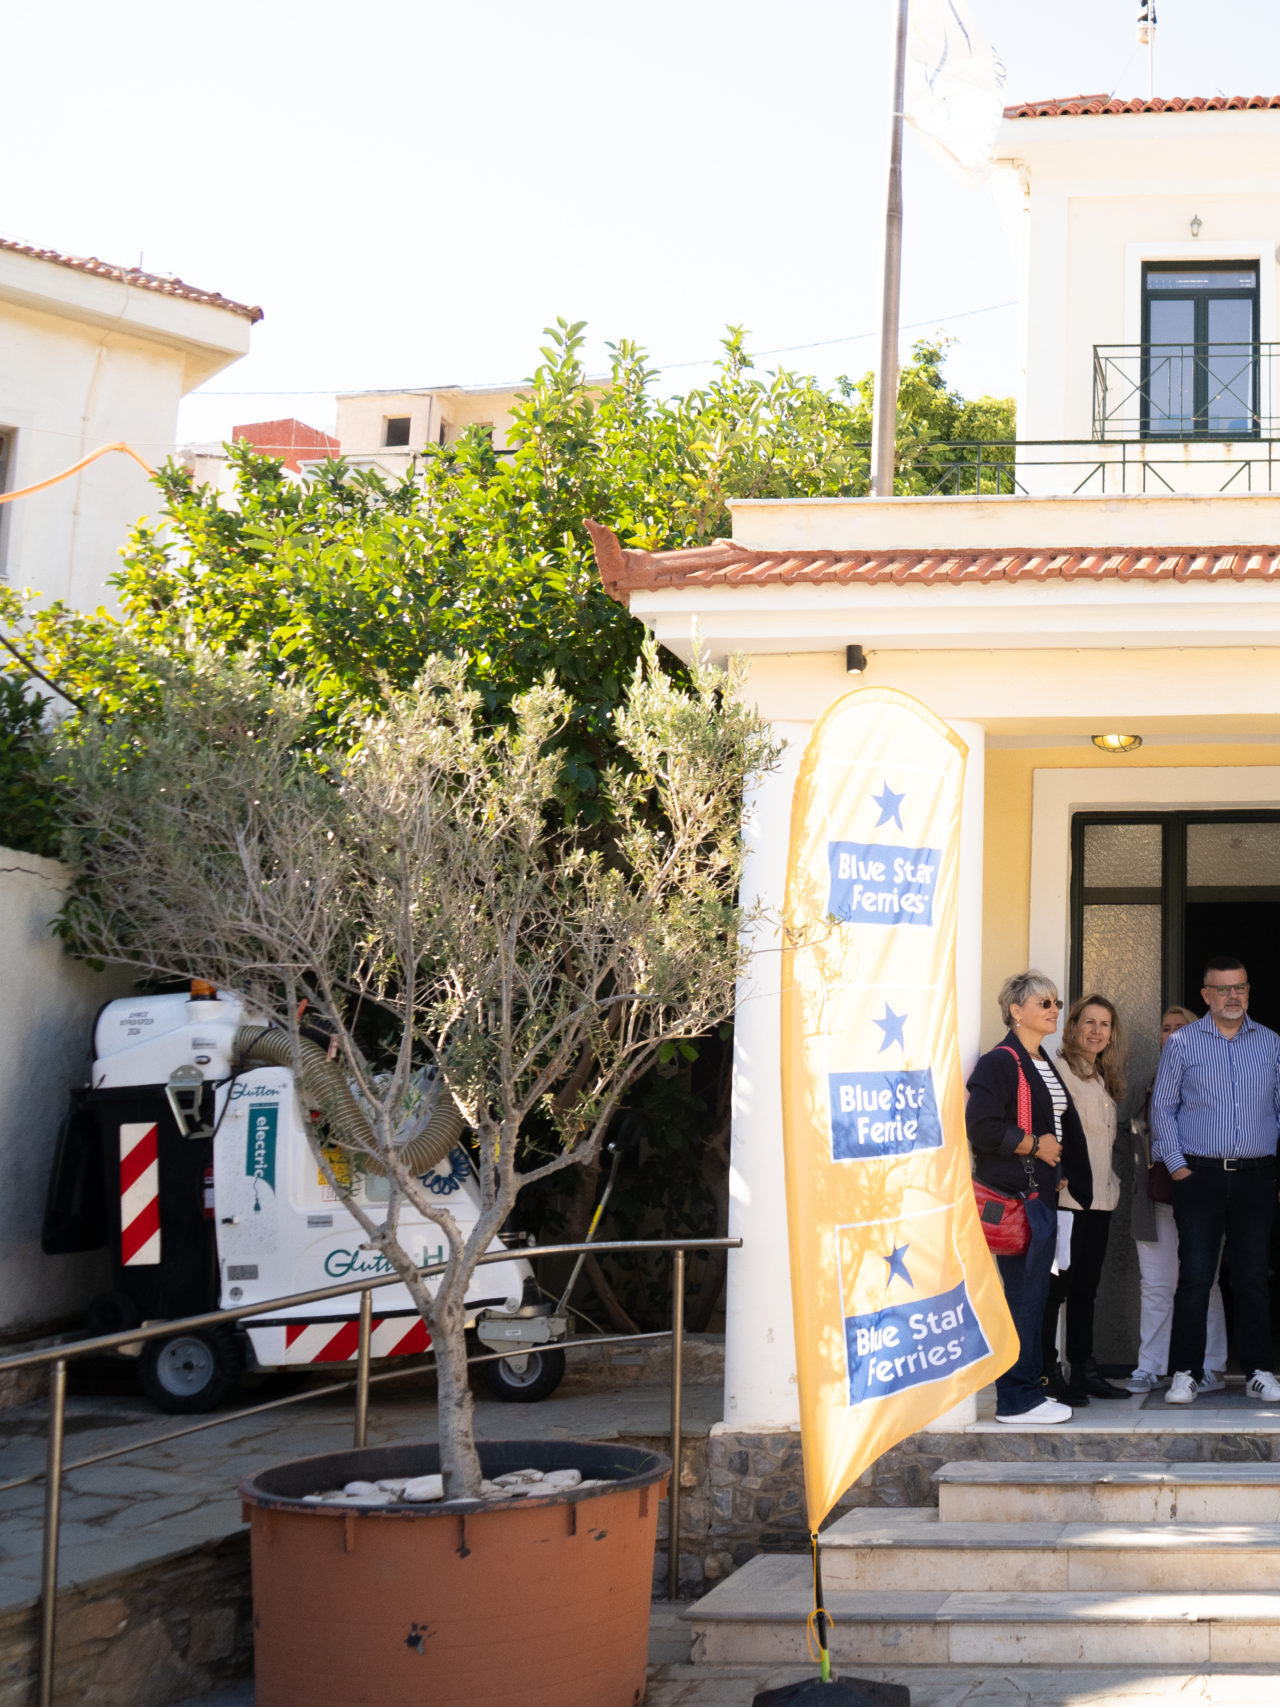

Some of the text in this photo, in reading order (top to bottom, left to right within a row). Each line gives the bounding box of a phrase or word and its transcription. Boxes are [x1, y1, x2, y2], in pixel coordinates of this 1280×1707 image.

[838, 852, 935, 884] Blue Star
[852, 884, 925, 914] Ferries
[230, 1082, 280, 1100] Glutton
[840, 1084, 893, 1112] Blue
[858, 1115, 918, 1145] Ferrie
[254, 1116, 270, 1178] electric
[325, 1249, 417, 1277] Glutt
[856, 1302, 964, 1356] Blue Star
[867, 1339, 963, 1387] Ferries
